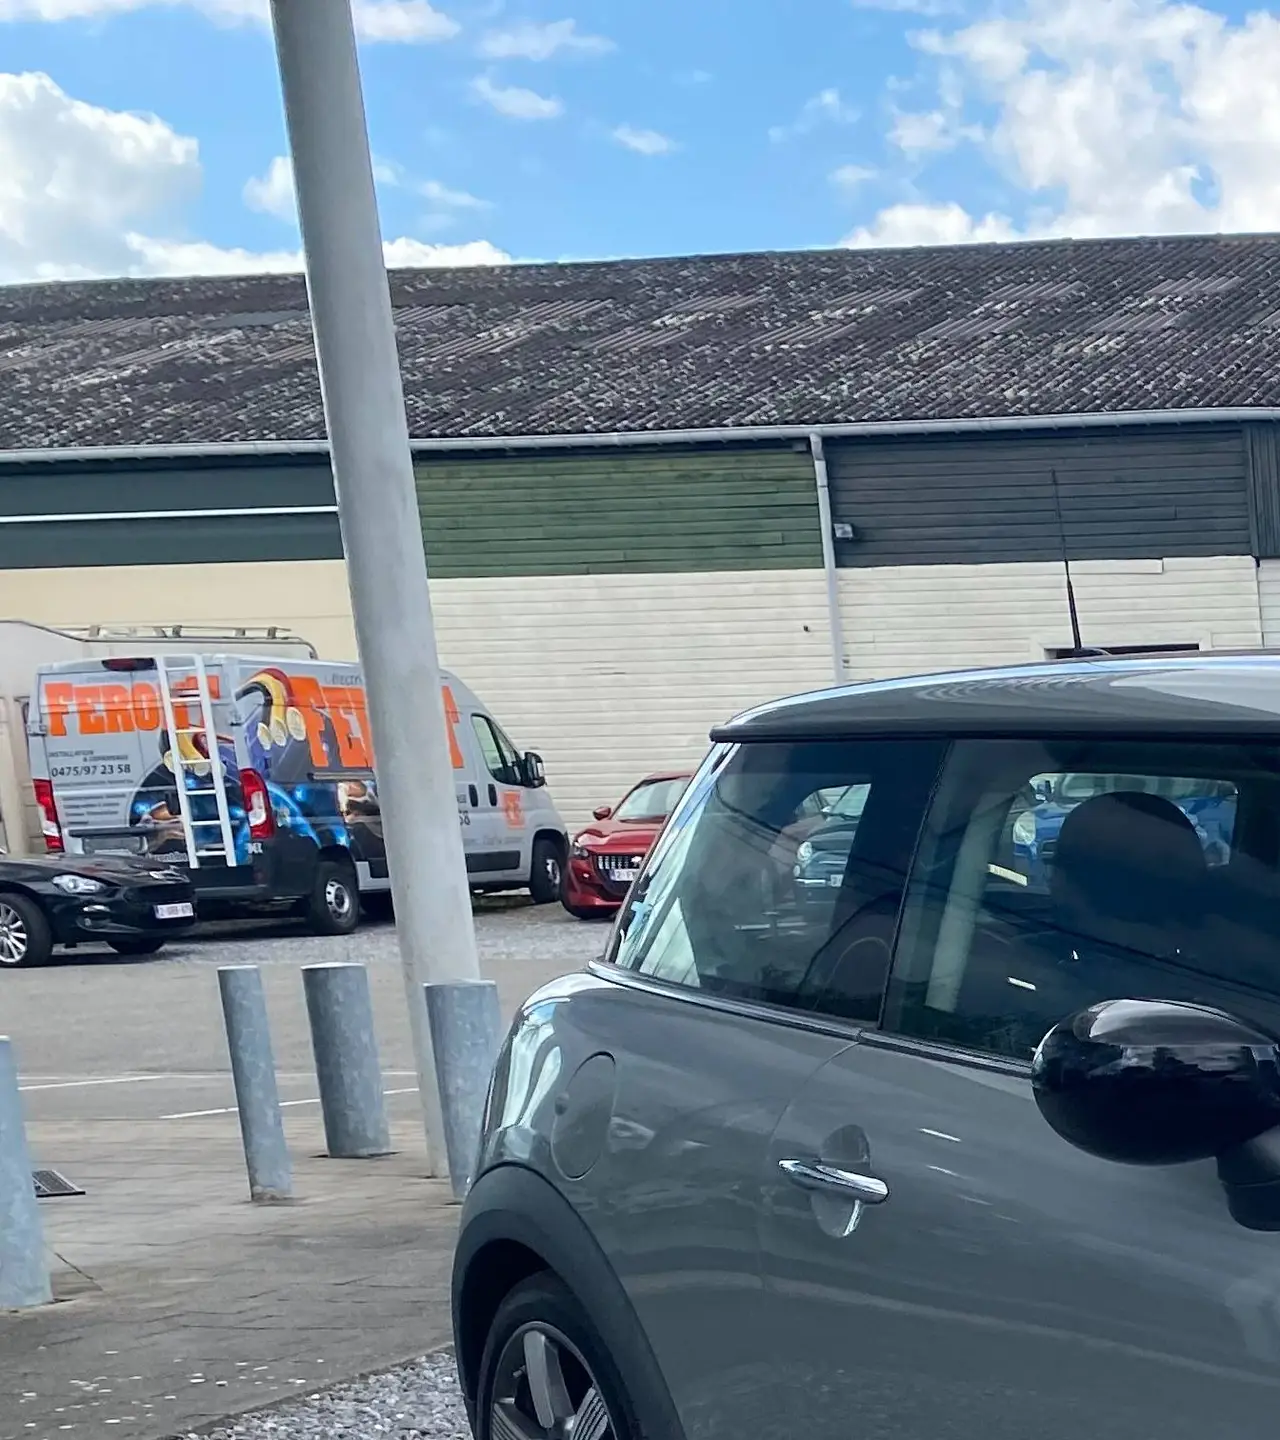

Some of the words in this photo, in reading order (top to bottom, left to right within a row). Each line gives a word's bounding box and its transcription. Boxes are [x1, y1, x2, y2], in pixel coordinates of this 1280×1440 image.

[51, 765, 97, 777] 0475/97
[100, 764, 114, 775] 23
[117, 763, 131, 774] 58
